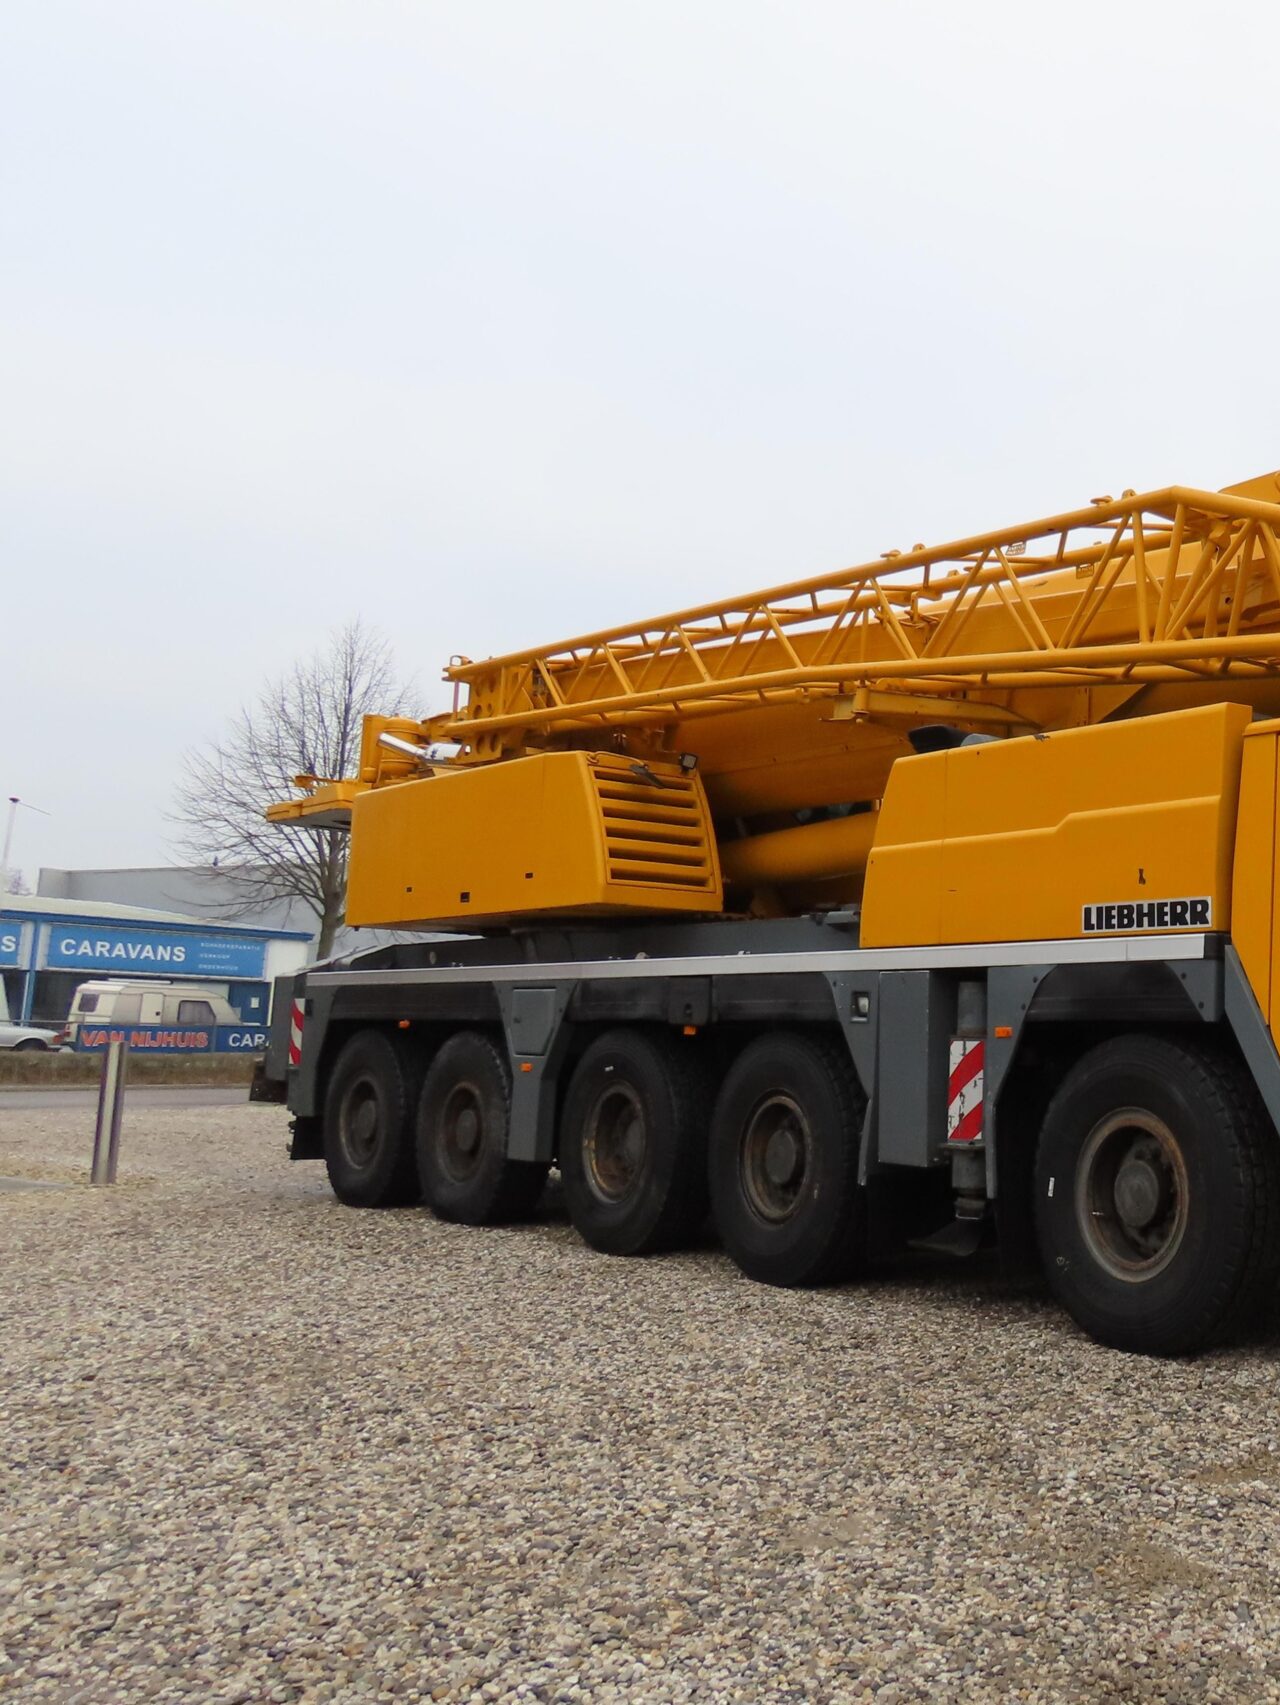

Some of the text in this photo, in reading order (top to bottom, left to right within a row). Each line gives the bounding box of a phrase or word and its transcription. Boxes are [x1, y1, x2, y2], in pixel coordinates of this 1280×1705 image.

[1084, 899, 1210, 931] LIEBHERR
[60, 938, 186, 962] CARAVANS
[80, 1030, 270, 1048] VAN NIJHUIS CAR
